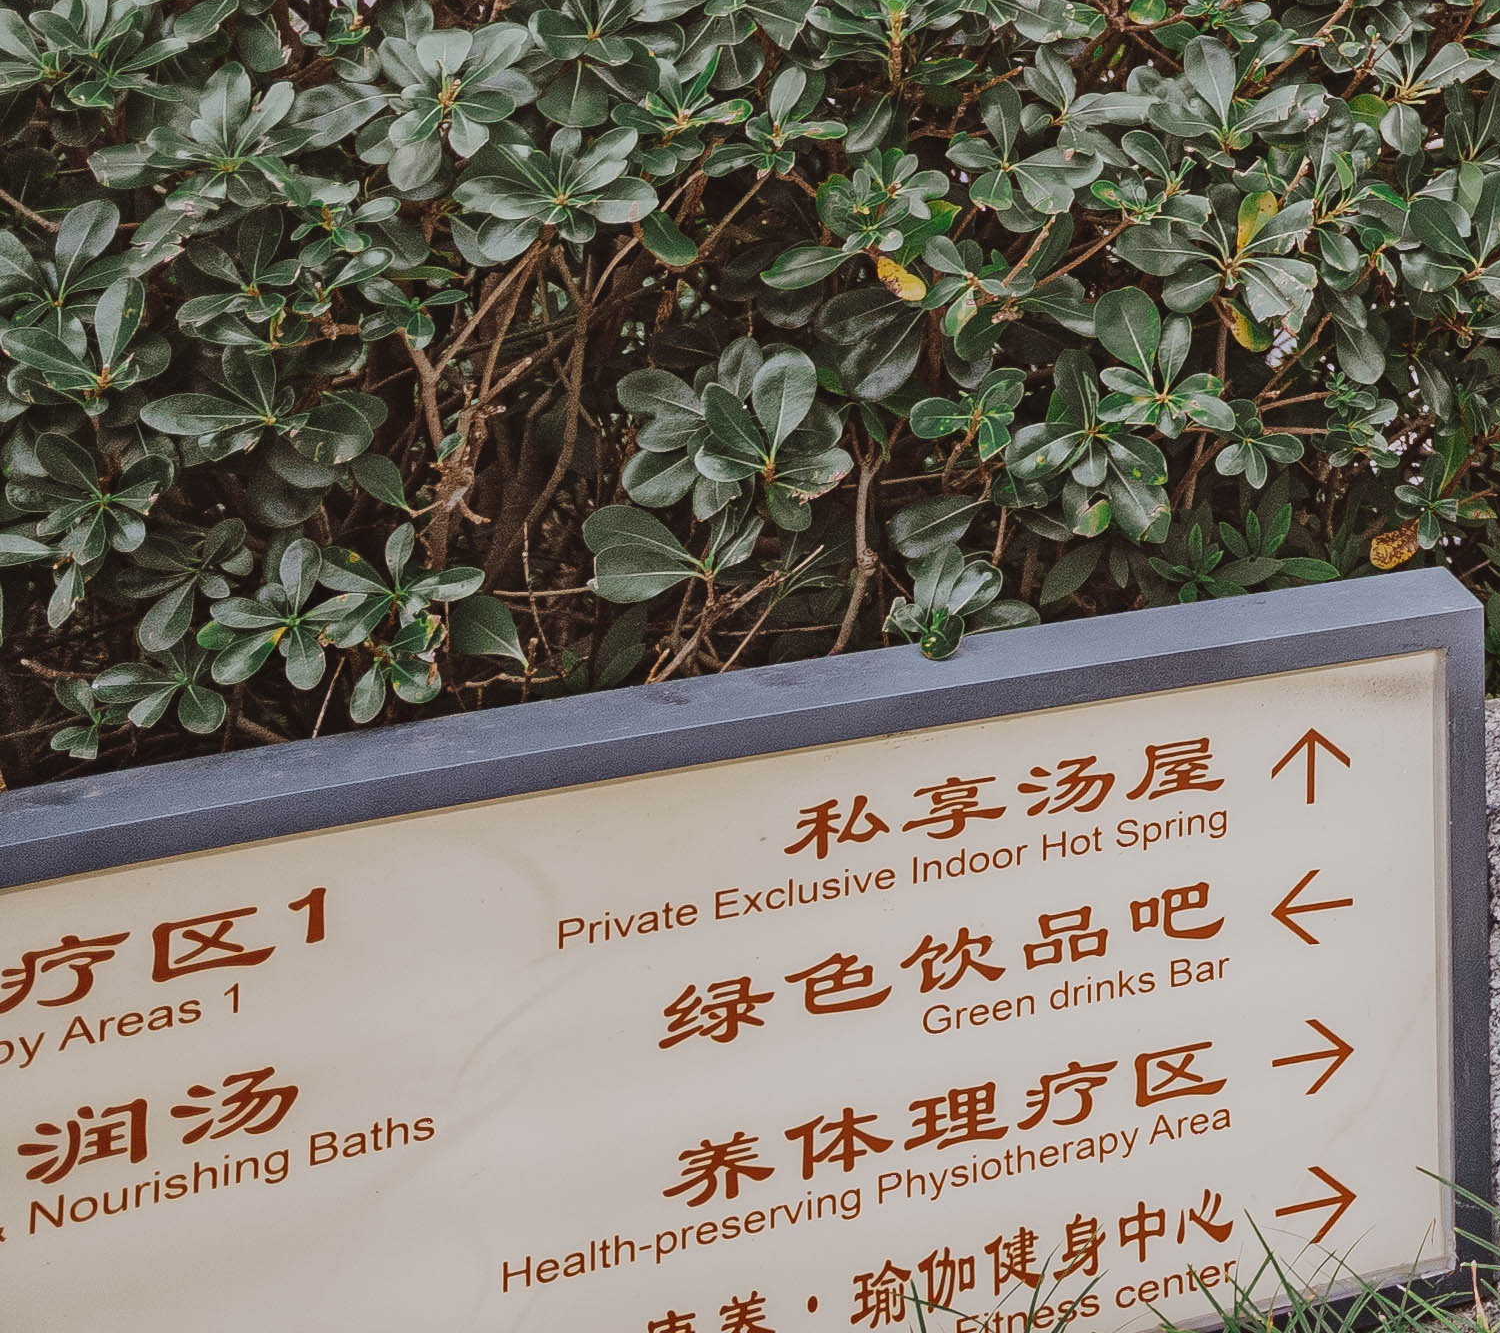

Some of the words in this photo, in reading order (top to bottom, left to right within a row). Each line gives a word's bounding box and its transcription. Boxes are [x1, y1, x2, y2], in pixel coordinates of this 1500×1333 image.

[783, 737, 1225, 860] 私享汤屋
[557, 901, 698, 950] Private
[714, 868, 896, 921] Exclusive
[912, 844, 1028, 884] Indoor
[1042, 828, 1103, 862] Hot
[1116, 809, 1228, 851] Spring
[58, 999, 203, 1051] Areas
[223, 982, 240, 1015] 1
[658, 881, 1225, 1050] 绿色饮品吧
[922, 994, 1036, 1035] Green
[1049, 970, 1156, 1011] drinks
[1170, 957, 1231, 988] Bar
[16, 1066, 299, 1185] 润汤
[29, 1148, 291, 1234] Nourishing
[308, 1115, 436, 1167] Baths
[662, 1041, 1227, 1208] 养体理疗区
[502, 1187, 862, 1294] Health-preserving
[877, 1127, 1139, 1205] Physiotherapy
[1149, 1107, 1232, 1145] Area
[955, 1294, 1102, 1333] Fitness
[1115, 1259, 1237, 1310] center
